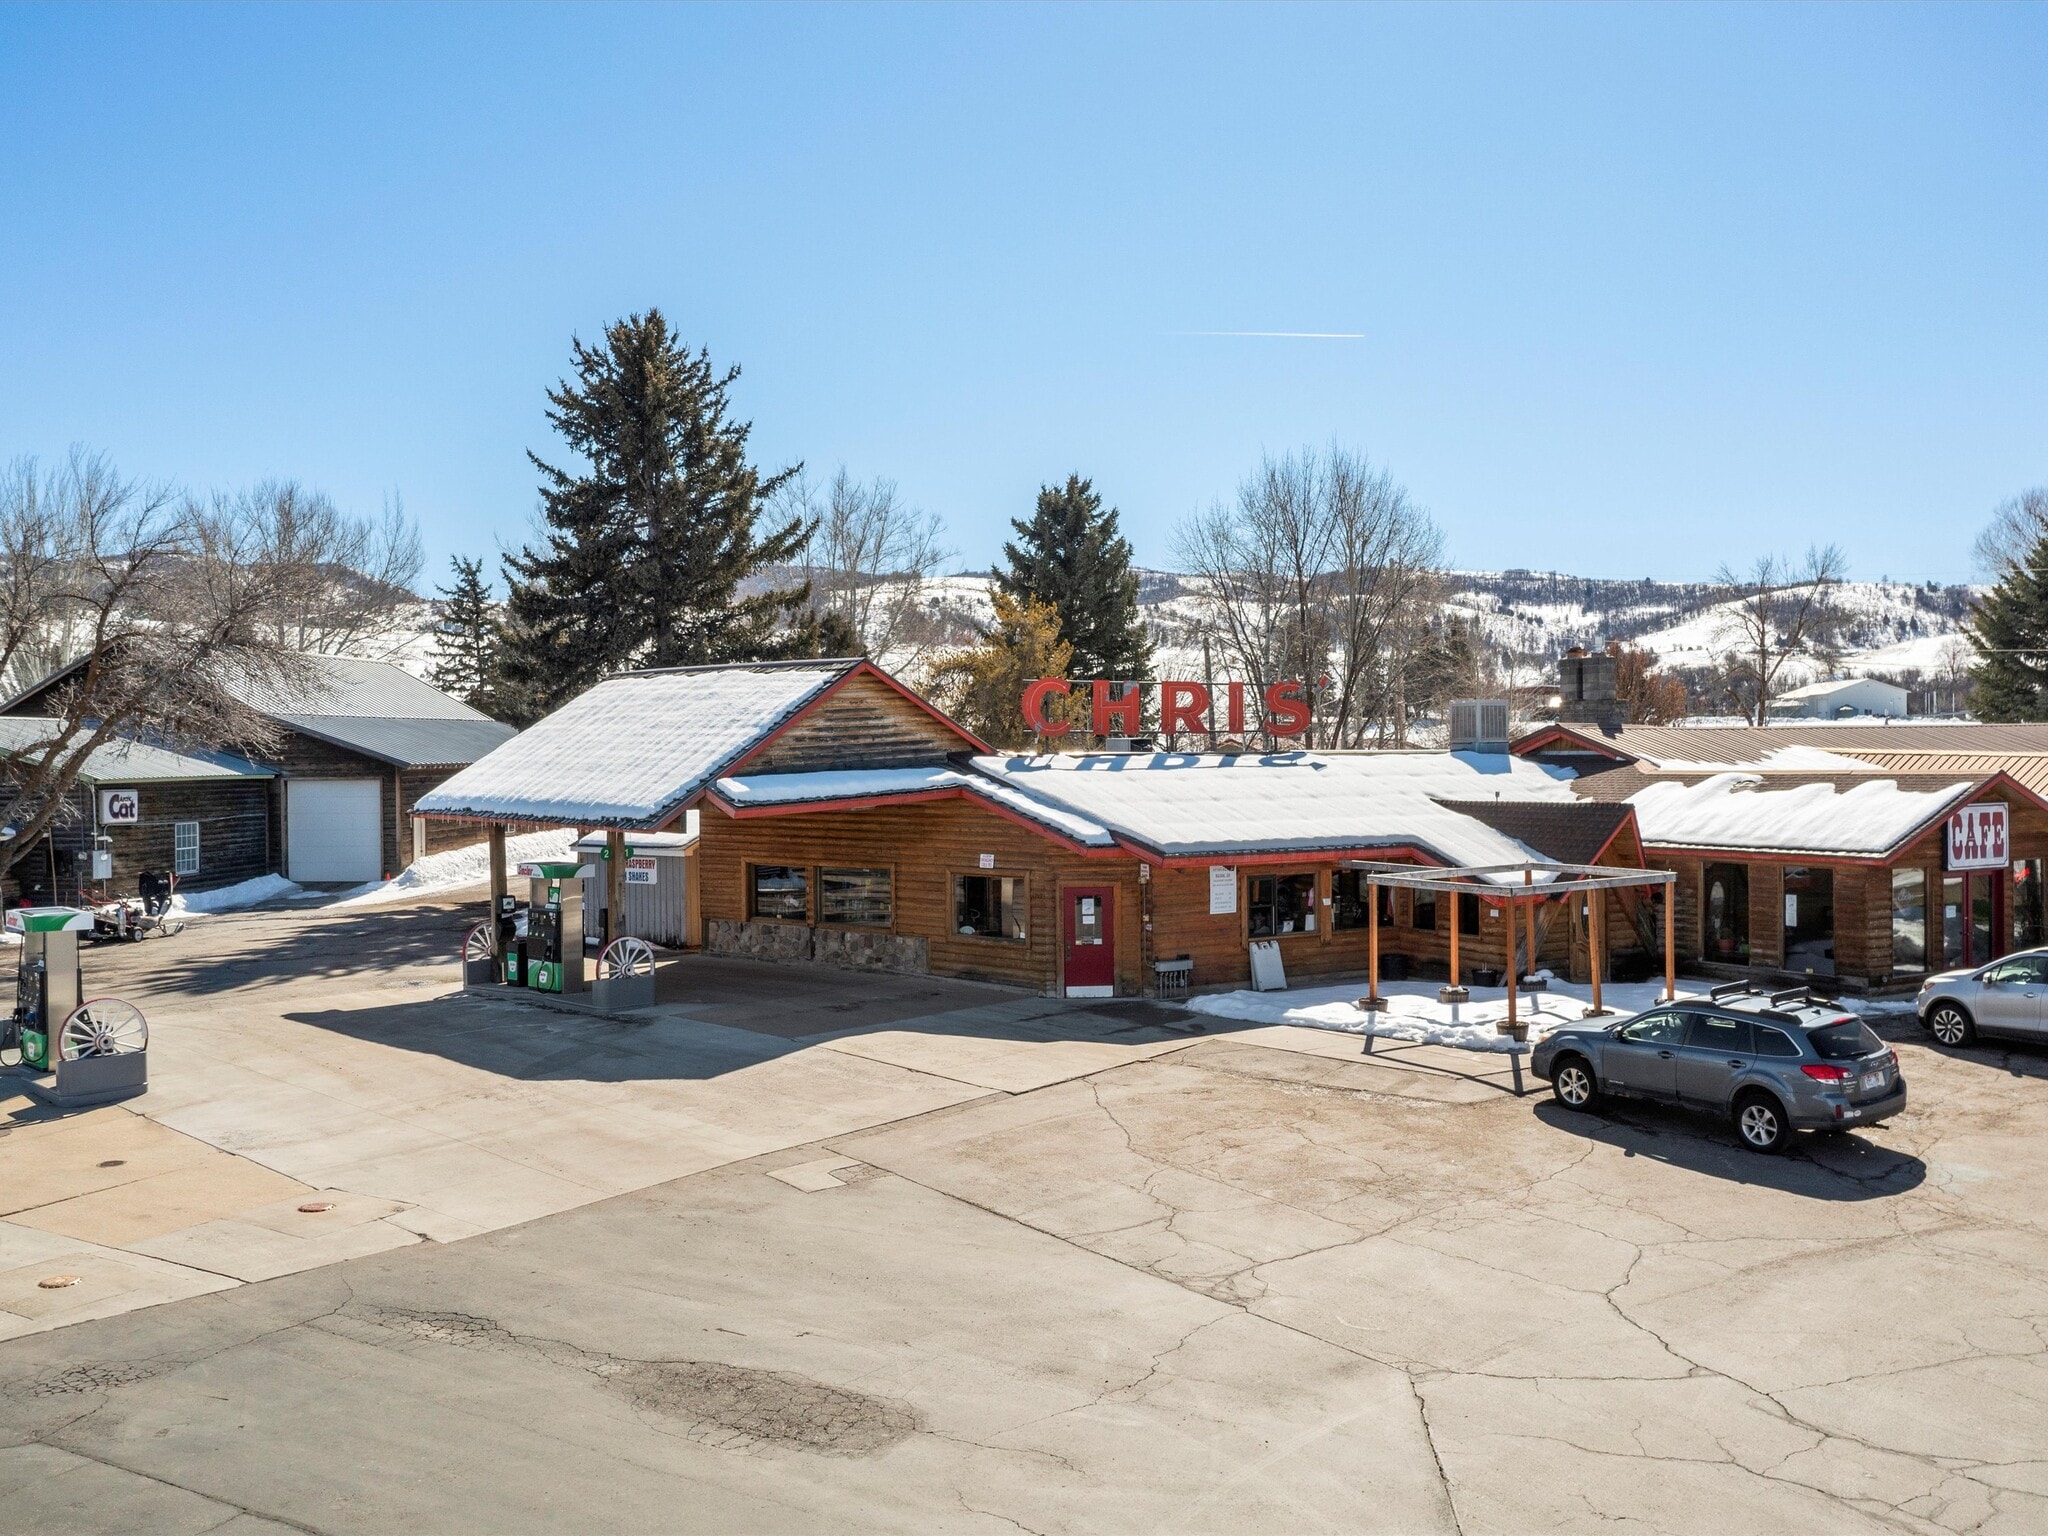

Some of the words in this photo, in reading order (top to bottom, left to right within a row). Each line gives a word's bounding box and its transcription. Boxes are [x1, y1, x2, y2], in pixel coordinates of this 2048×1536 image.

[109, 793, 136, 820] Cat
[1952, 811, 2005, 861] CAFE
[603, 849, 610, 859] 2
[628, 871, 649, 882] SHAKES
